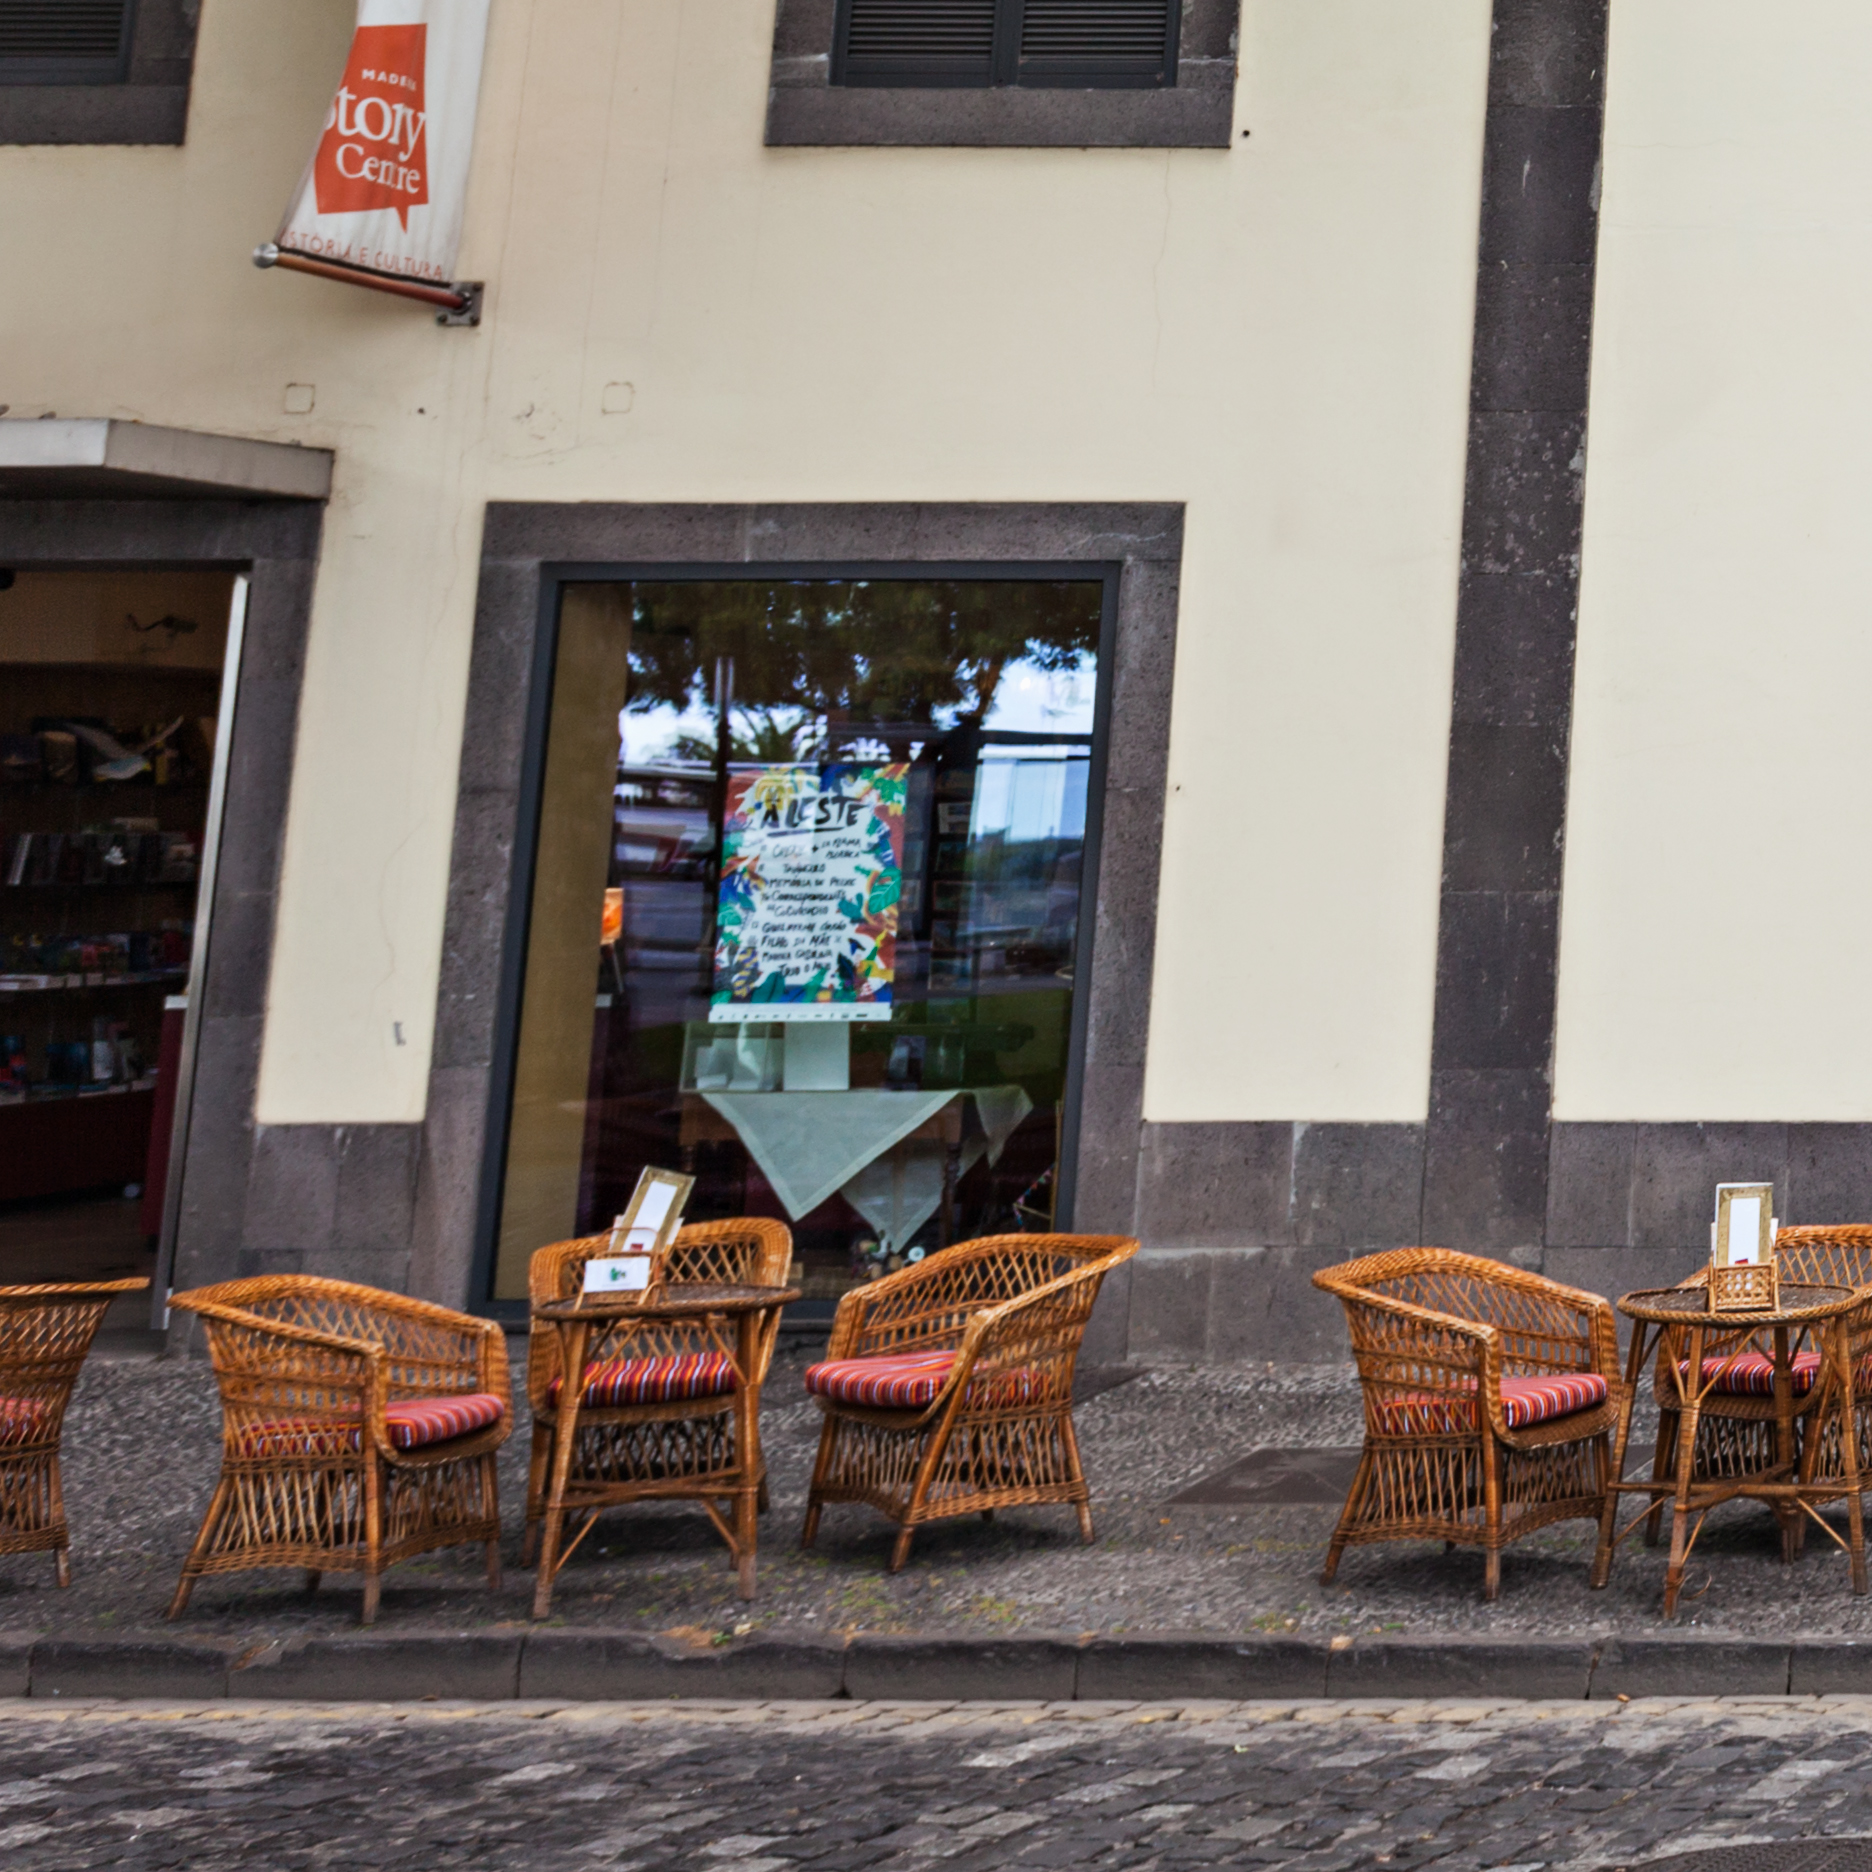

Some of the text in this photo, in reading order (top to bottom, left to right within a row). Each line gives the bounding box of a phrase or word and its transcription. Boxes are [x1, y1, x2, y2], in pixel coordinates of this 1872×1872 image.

[325, 85, 428, 162] tory
[336, 142, 421, 195] Cenre
[358, 247, 369, 264] E
[374, 251, 443, 279] CULTURA
[785, 796, 868, 828] LESTE
